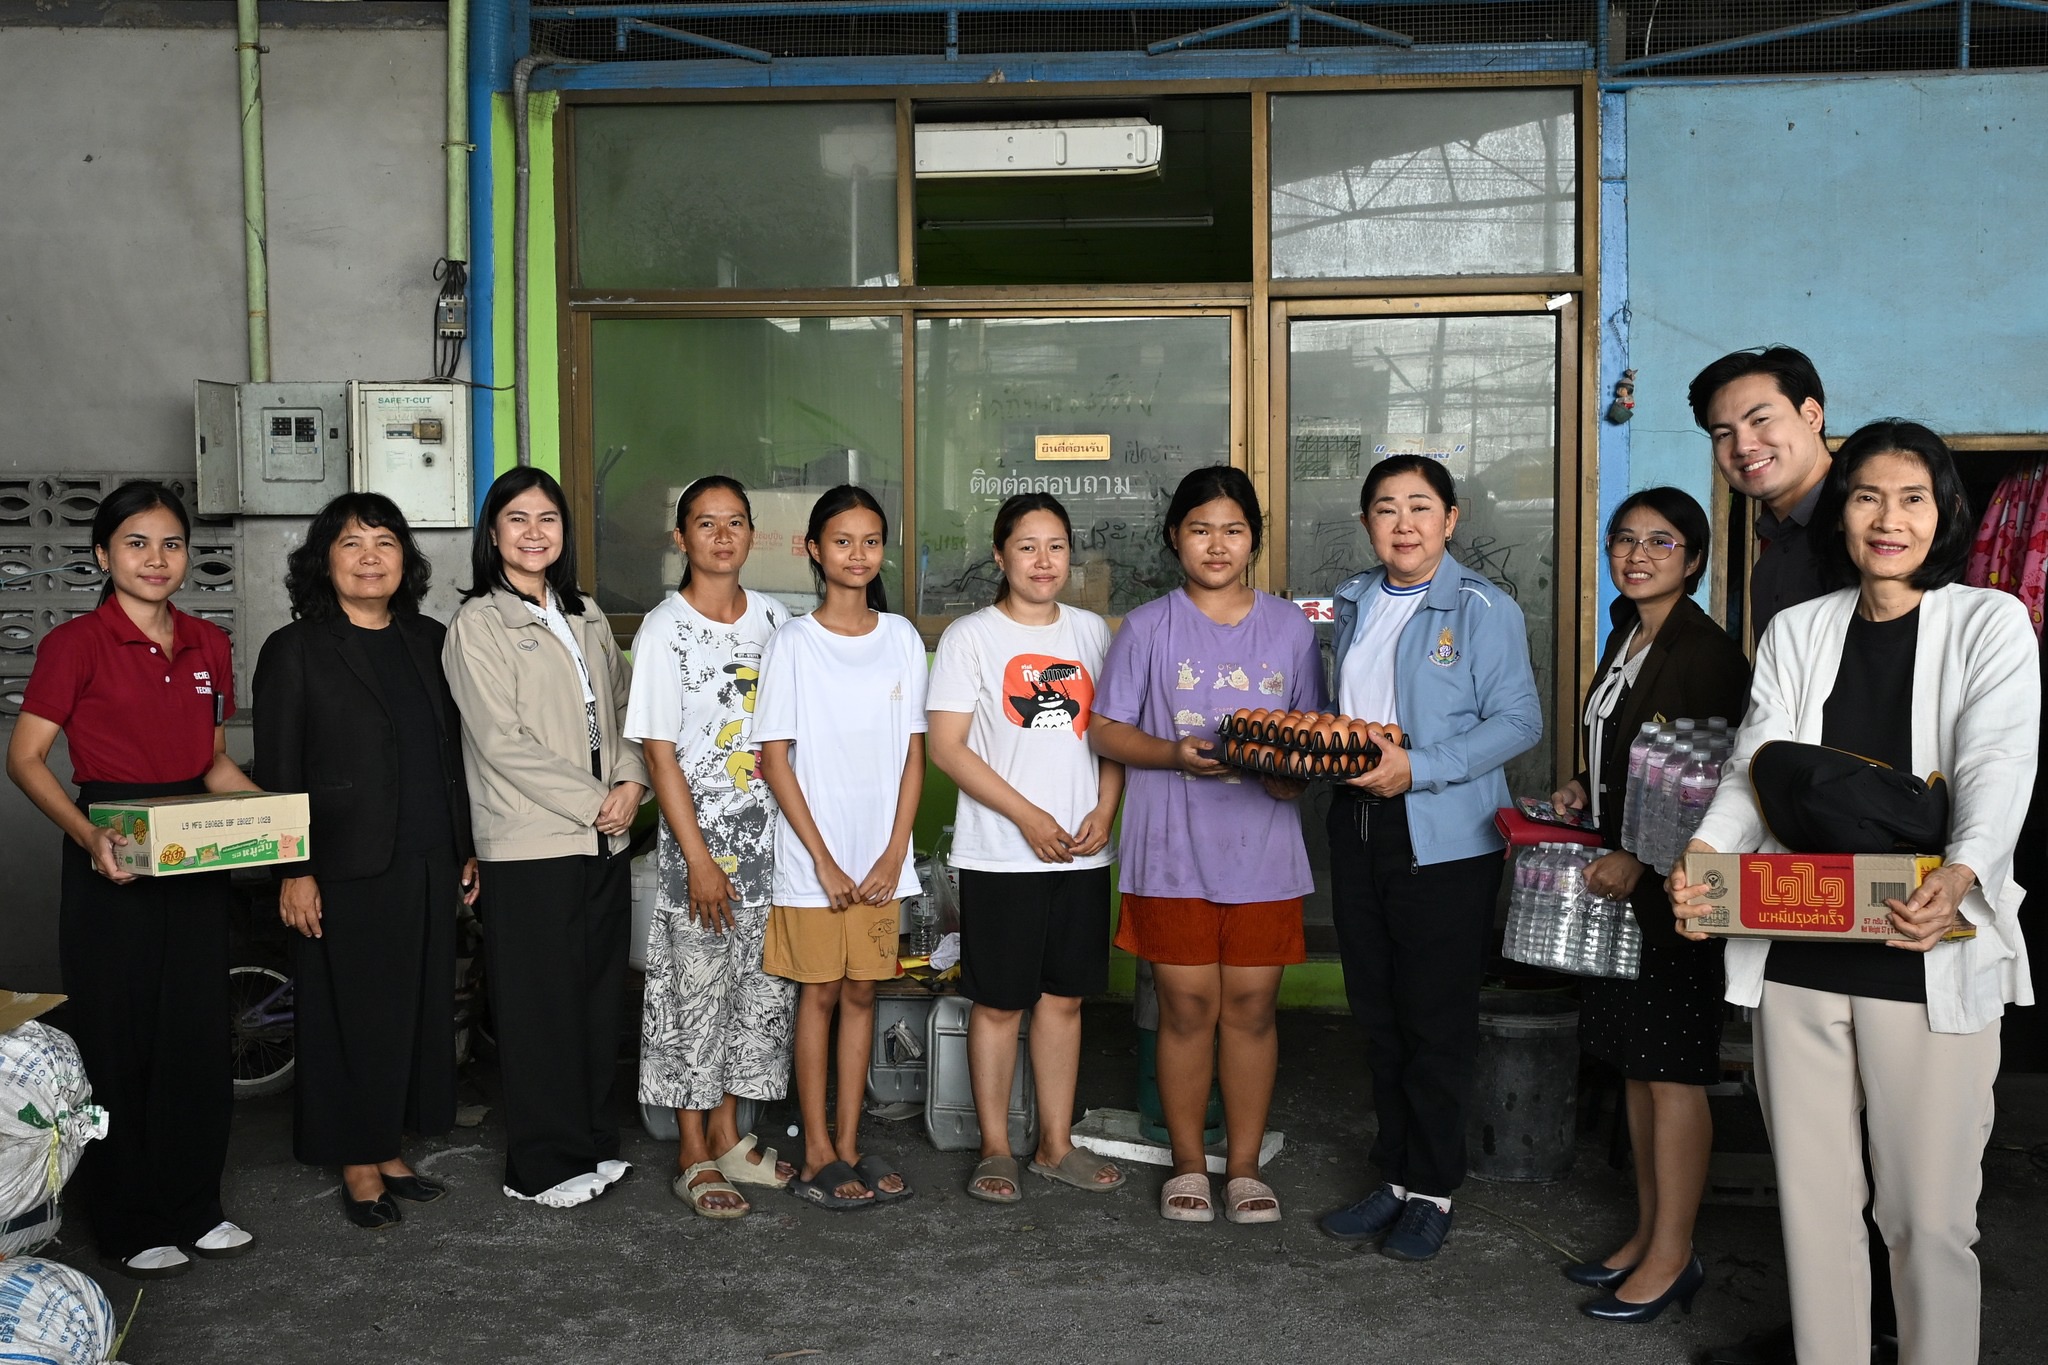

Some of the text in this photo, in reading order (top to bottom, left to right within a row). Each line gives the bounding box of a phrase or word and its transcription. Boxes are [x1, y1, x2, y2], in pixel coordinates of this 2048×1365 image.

[1041, 442, 1104, 454] ยินดีต้อนรับ
[970, 468, 1130, 495] ติดต่อสอบถาม
